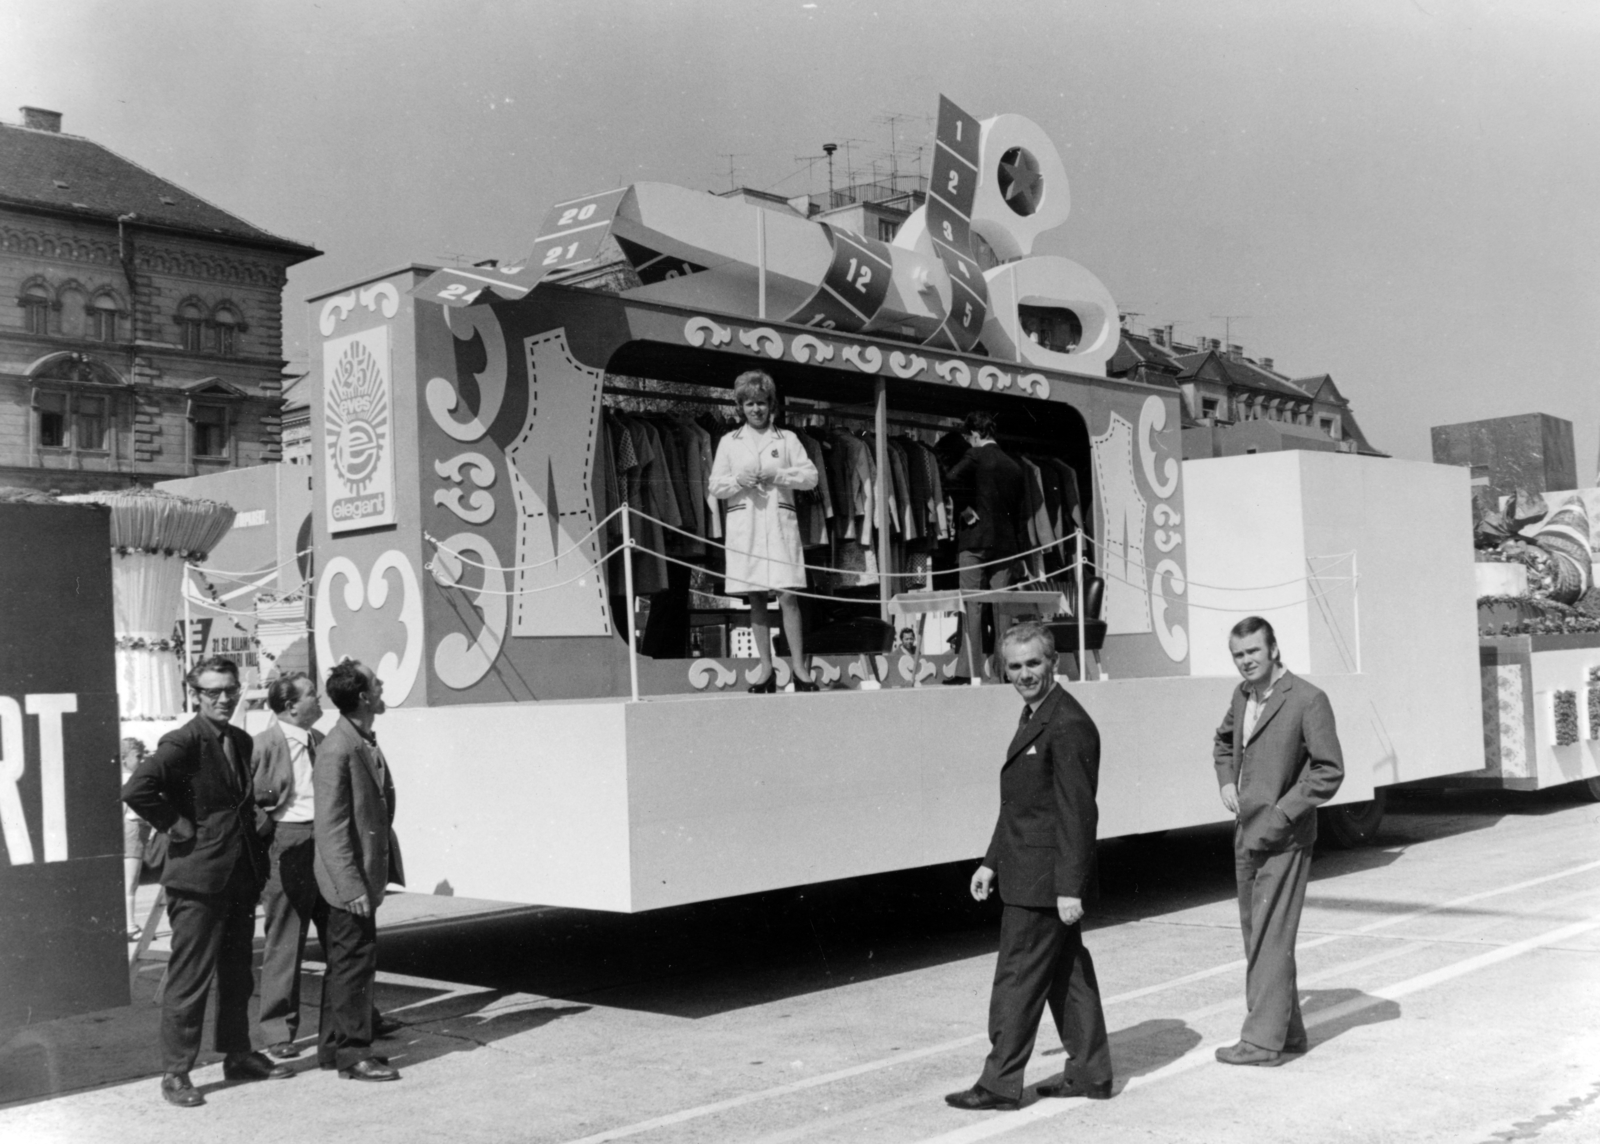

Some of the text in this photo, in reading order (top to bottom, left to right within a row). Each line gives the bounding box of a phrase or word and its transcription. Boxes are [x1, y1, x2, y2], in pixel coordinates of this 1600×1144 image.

[956, 120, 963, 142] 1
[948, 170, 959, 195] 2
[557, 203, 597, 226] 20
[943, 220, 953, 241] 3
[542, 241, 579, 266] 21
[846, 257, 872, 294] 12
[963, 302, 972, 328] 5
[342, 357, 367, 389] 25
[333, 493, 383, 519] elegant
[0, 693, 77, 865] RT
